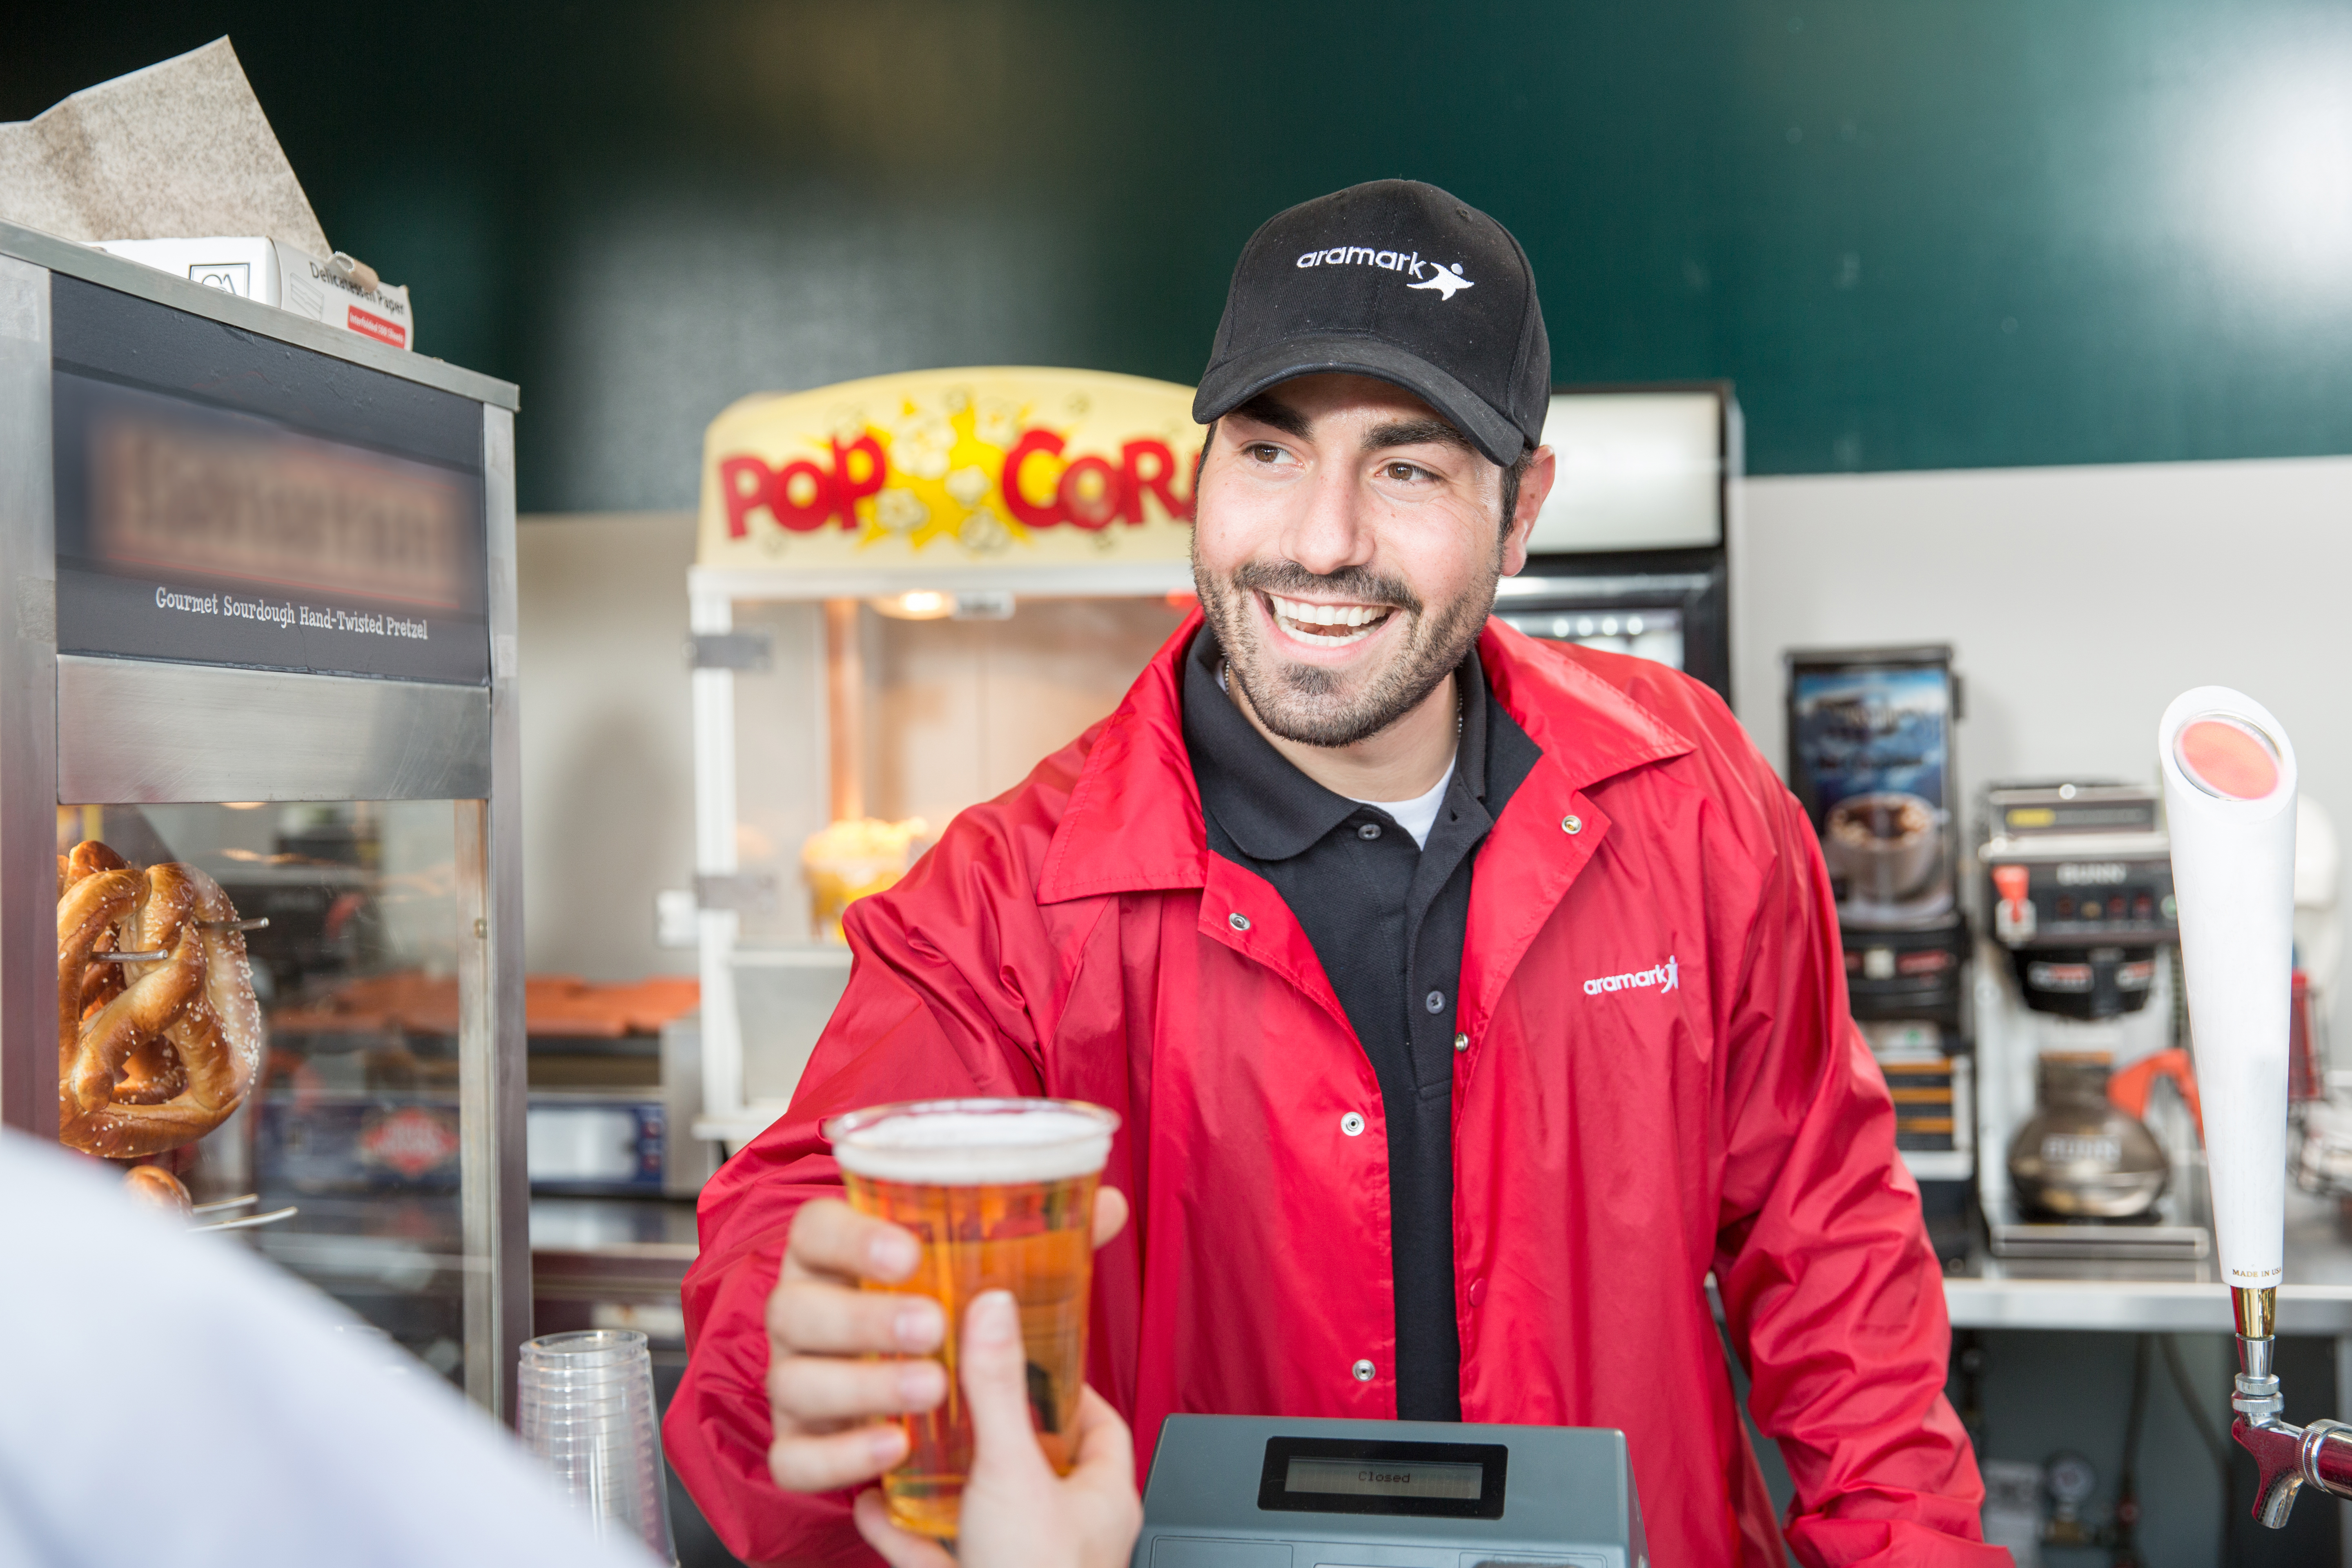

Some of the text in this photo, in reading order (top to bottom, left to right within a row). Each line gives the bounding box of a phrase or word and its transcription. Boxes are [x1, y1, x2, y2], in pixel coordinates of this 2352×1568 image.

[1296, 247, 1426, 279] aramark
[376, 288, 404, 315] Paper
[350, 312, 377, 332] Interfolded
[388, 327, 403, 344] Sheets
[1002, 428, 1196, 531] COR
[156, 587, 428, 639] Gourmet Sourdough Hand-Twisted Pretzel
[1584, 964, 1667, 995] aramark
[2232, 1269, 2258, 1277] MADE
[1359, 1471, 1410, 1483] Closed
